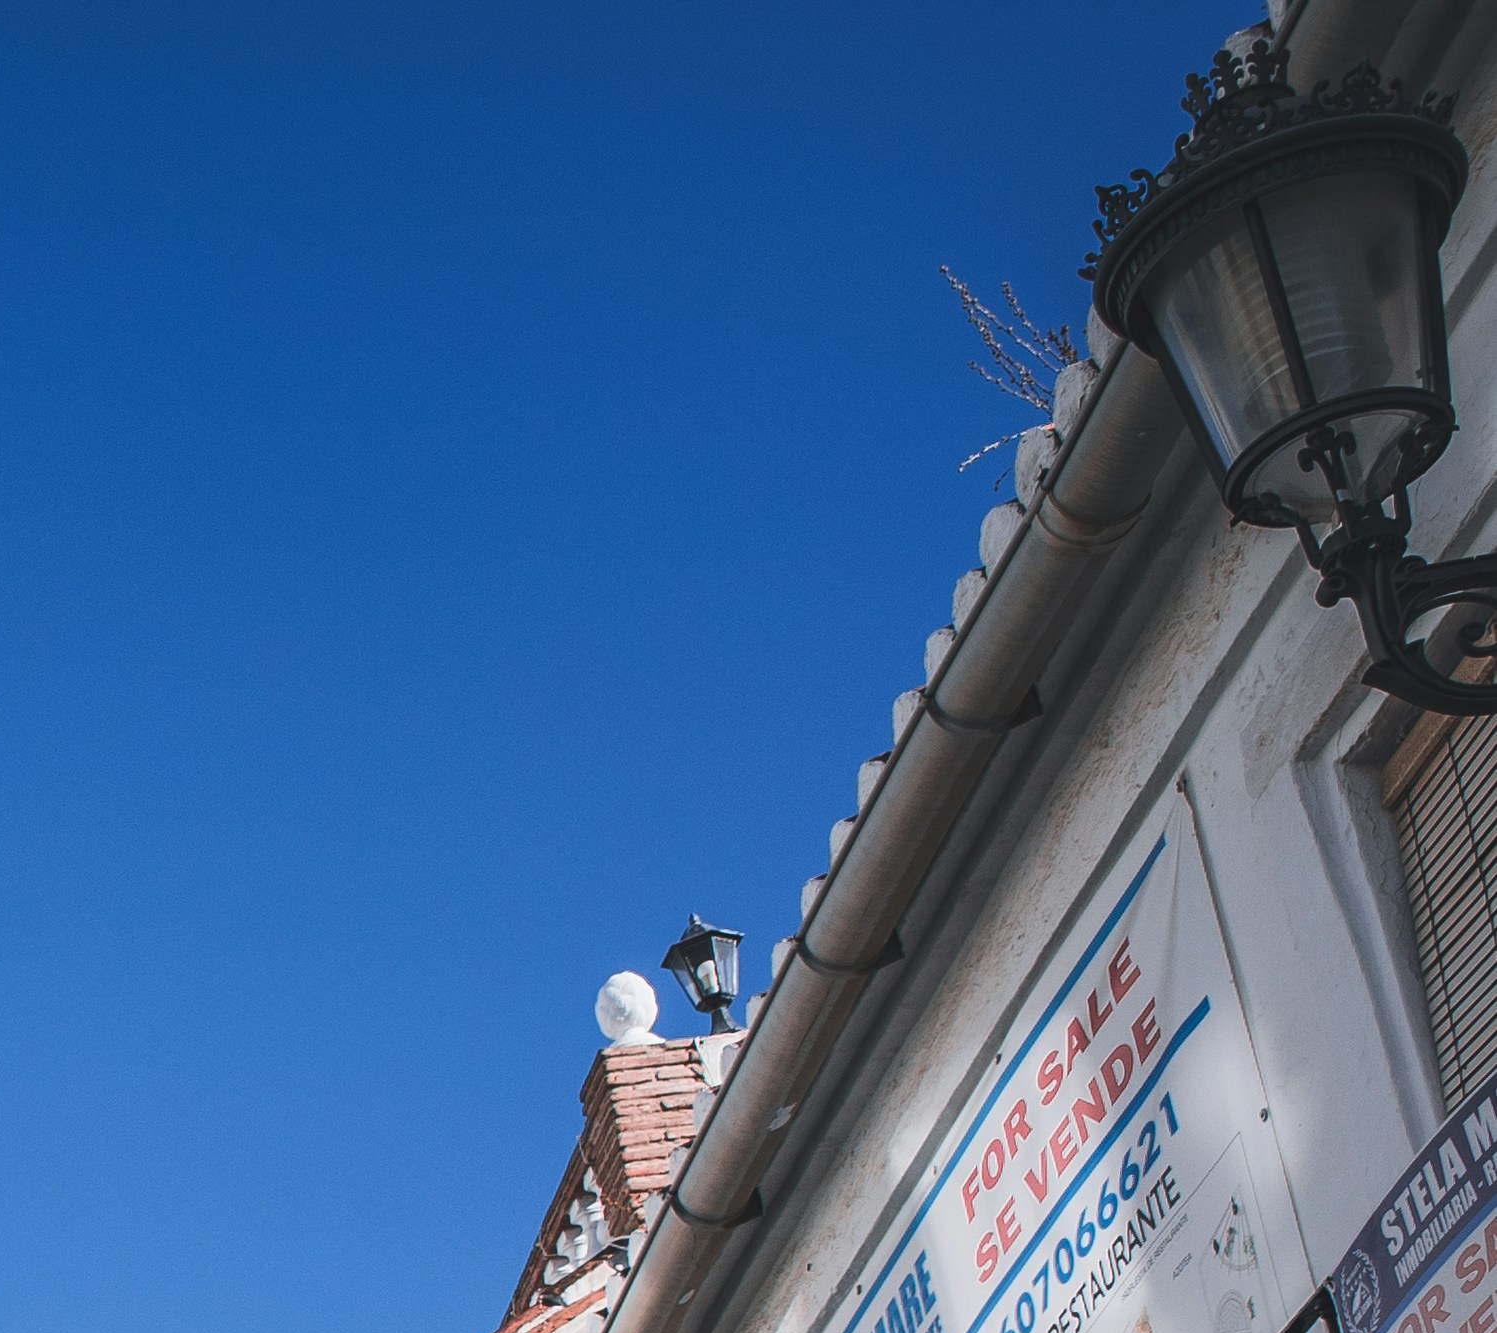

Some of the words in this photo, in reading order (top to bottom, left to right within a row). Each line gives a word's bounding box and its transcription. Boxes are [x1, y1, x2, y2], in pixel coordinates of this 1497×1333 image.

[961, 1098, 1033, 1224] FOR
[1037, 935, 1141, 1107] SALE
[976, 1196, 1021, 1284] SE
[1024, 996, 1161, 1203] VENDE
[1381, 1137, 1466, 1256] STELA
[1462, 1096, 1497, 1163] M
[1394, 1179, 1478, 1288] INMOBILIARIA
[1482, 1159, 1497, 1187] R
[1455, 1215, 1497, 1293] SA
